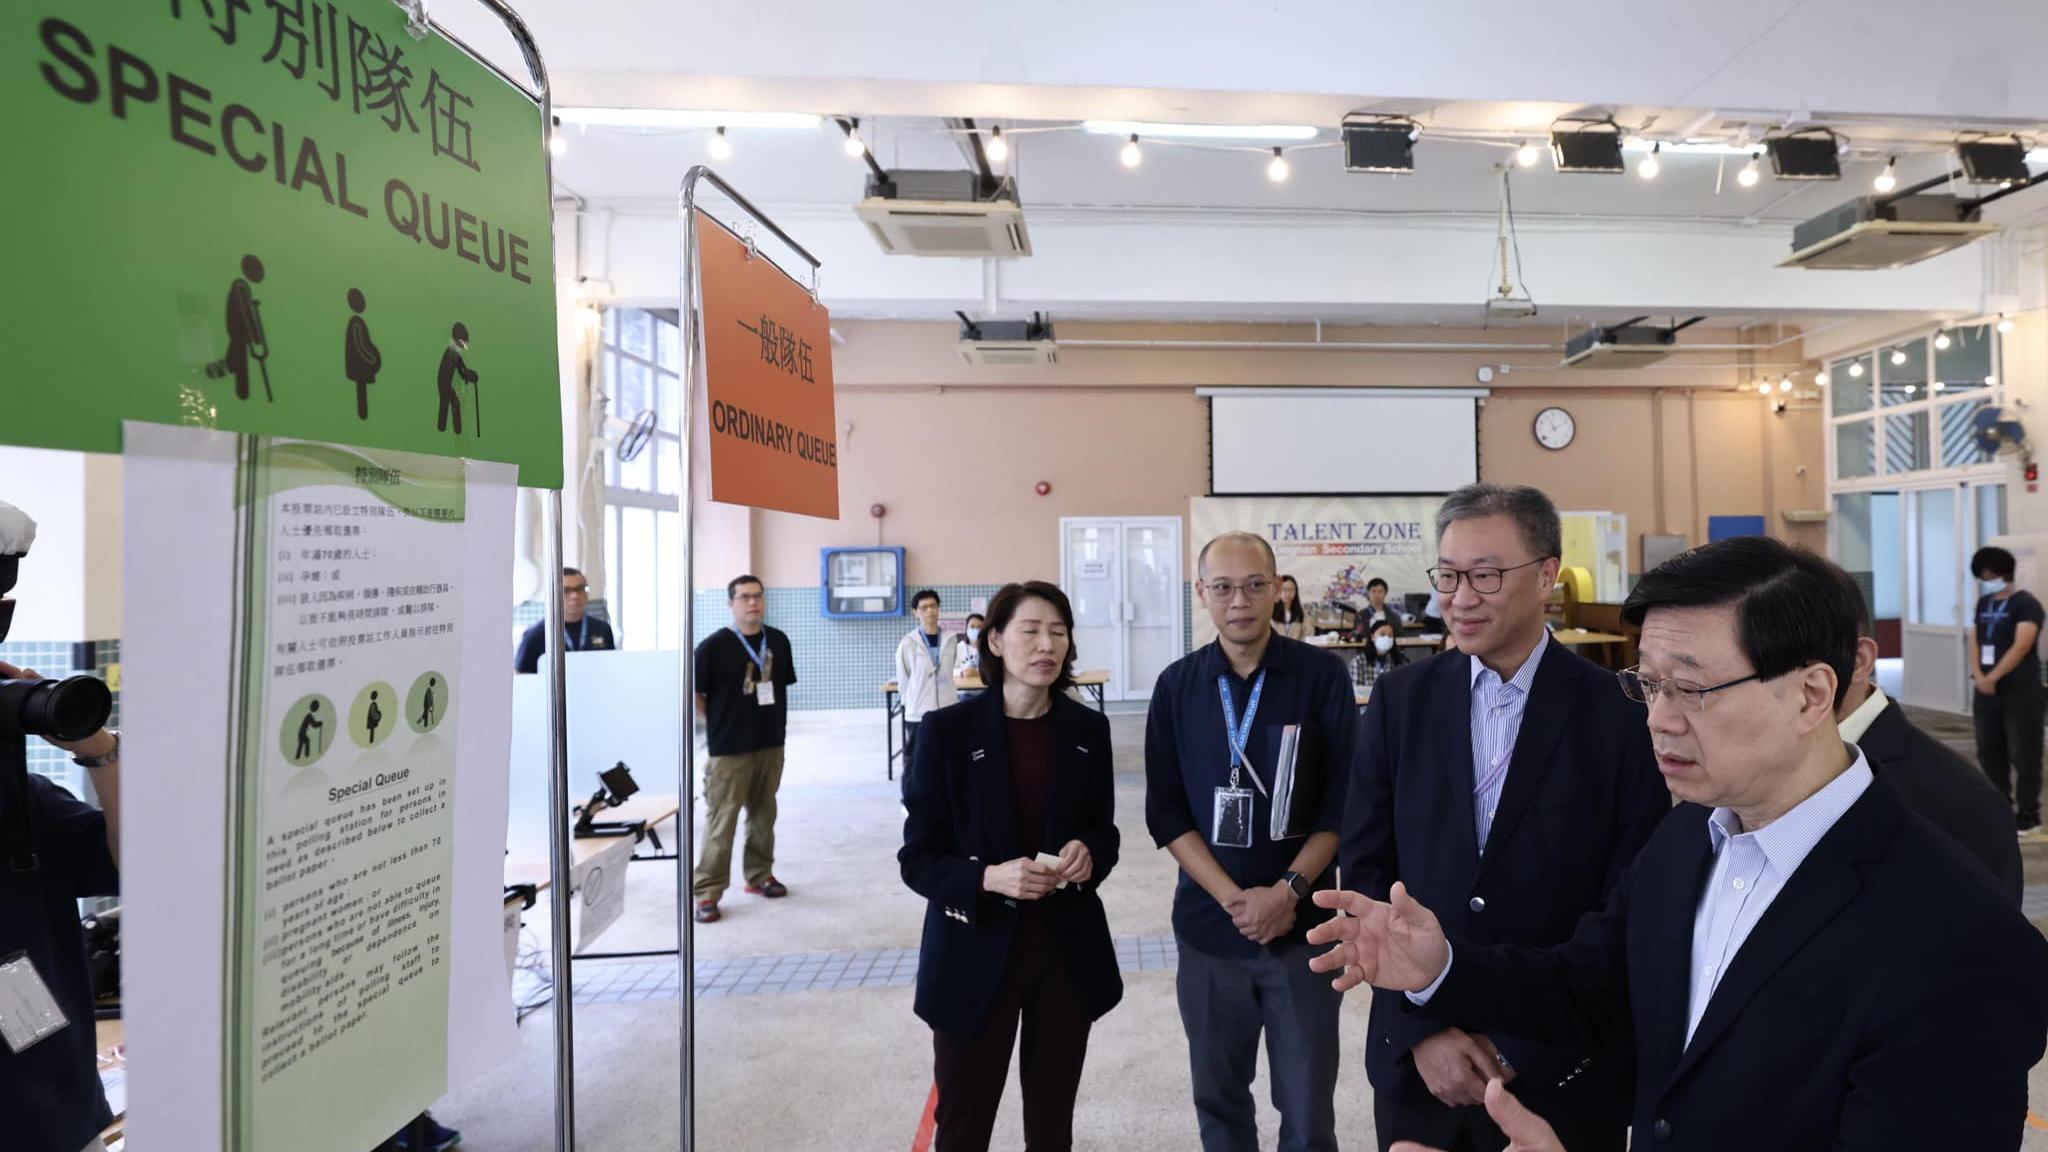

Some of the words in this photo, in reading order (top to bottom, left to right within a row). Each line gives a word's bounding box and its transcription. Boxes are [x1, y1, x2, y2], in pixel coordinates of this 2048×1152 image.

[38, 16, 368, 218] SPECIAL
[384, 178, 531, 285] QUEUE
[737, 314, 815, 383] 一般隊伍
[712, 400, 793, 454] ORDINARY
[796, 431, 836, 468] QUEUE
[1267, 523, 1357, 541] TALENT
[1363, 522, 1421, 540] ZONE
[1323, 543, 1381, 557] Secondary
[267, 836, 274, 846] A
[281, 820, 318, 842] special
[324, 809, 354, 827] queue
[360, 803, 376, 813] has
[382, 793, 402, 806] been
[407, 788, 420, 798] set
[424, 782, 434, 793] up
[439, 778, 446, 786] in
[328, 777, 372, 802] Special
[375, 768, 410, 787] Queue
[266, 846, 287, 861] this
[296, 831, 331, 852] polling
[339, 816, 373, 834] station
[380, 808, 393, 819] for
[400, 795, 432, 814] persons
[439, 790, 446, 799] in
[266, 858, 292, 876] need
[298, 852, 309, 864] as
[314, 832, 362, 857] described
[367, 821, 393, 837] below
[397, 815, 406, 826] to
[409, 805, 437, 821] collect
[266, 871, 296, 891] ballot
[299, 858, 328, 878] paper
[283, 888, 323, 913] persons
[328, 878, 348, 890] who
[353, 869, 368, 881] are
[372, 860, 386, 872] not
[390, 852, 407, 865] less
[410, 844, 428, 855] than
[432, 836, 441, 846] 70
[327, 917, 346, 932] who
[350, 909, 363, 922] are
[367, 900, 381, 913] not
[384, 892, 402, 905] able
[404, 886, 413, 895] to
[416, 873, 440, 890] queue
[281, 956, 296, 968] for
[300, 952, 306, 960] a
[309, 939, 331, 955] long
[334, 927, 354, 942] time
[357, 921, 367, 931] or
[370, 910, 390, 925] have
[393, 890, 430, 914] difficulty
[432, 886, 440, 894] in
[282, 912, 327, 942] pregnant
[372, 888, 382, 898] or
[283, 907, 309, 928] years
[314, 900, 324, 911] of
[262, 1005, 307, 1037] Relevant
[318, 979, 356, 1007] persons
[366, 964, 384, 978] may
[393, 945, 418, 963] follow
[427, 933, 440, 944] the
[280, 968, 328, 998] disability
[343, 954, 352, 965] or
[366, 921, 417, 952] dependence
[429, 909, 440, 919] on
[281, 956, 322, 984] queuing
[331, 935, 364, 957] because
[371, 925, 380, 937] of
[262, 1011, 323, 1052] instructions
[337, 995, 347, 1007] of
[359, 973, 390, 996] polling
[402, 953, 420, 970] staff
[431, 945, 440, 954] to
[262, 1036, 304, 1069] proceed
[313, 1025, 323, 1036] to
[333, 1010, 348, 1023] the
[358, 983, 389, 1009] special
[399, 966, 423, 986] queue
[431, 957, 440, 966] to
[280, 985, 321, 1012] mobility
[262, 1054, 297, 1083] collect
[300, 1050, 306, 1058] a
[309, 1029, 337, 1051] ballot
